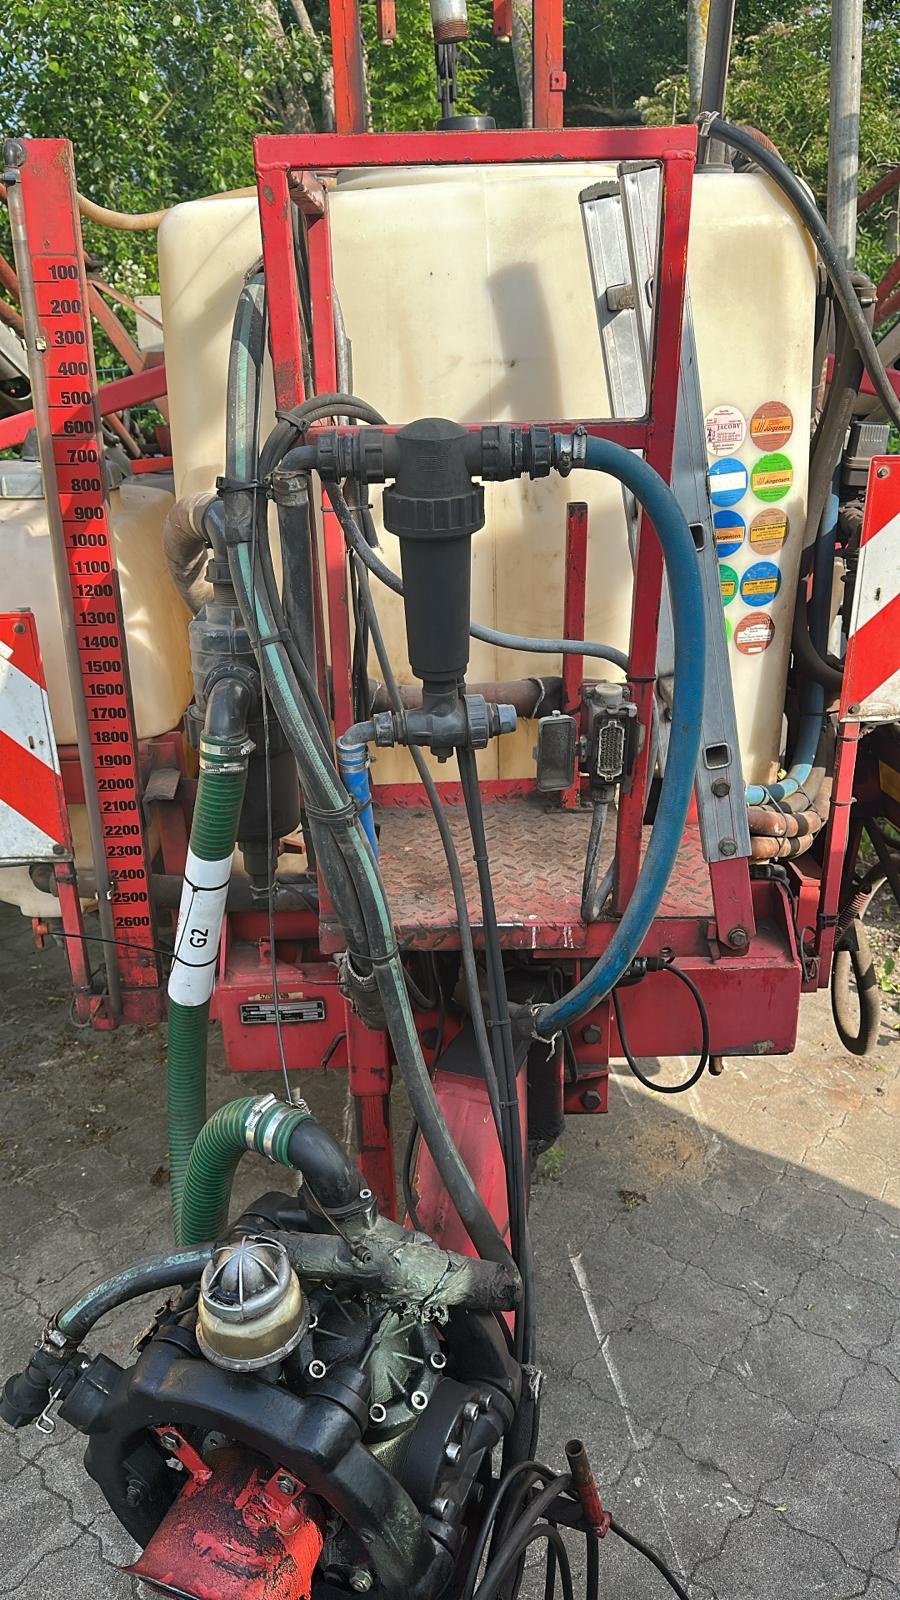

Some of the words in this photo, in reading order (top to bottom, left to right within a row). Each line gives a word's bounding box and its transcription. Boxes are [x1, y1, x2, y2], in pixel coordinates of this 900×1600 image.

[49, 266, 78, 279] 100
[51, 300, 80, 313] 200
[55, 331, 84, 344] 300
[58, 362, 88, 375] 400
[61, 392, 91, 404] 500
[64, 421, 93, 433] 600
[67, 450, 97, 462] 700
[72, 479, 100, 491] 800
[74, 507, 103, 519] 900
[70, 534, 107, 546] 1000
[75, 561, 110, 573] 1100
[76, 585, 112, 596] 1200
[80, 612, 115, 624] 1300
[83, 636, 118, 647] 1400
[86, 661, 121, 672] 1500
[89, 684, 123, 695] 1600
[92, 708, 126, 718] 1700
[94, 732, 128, 743] 1800
[97, 755, 131, 766] 1900
[98, 779, 134, 790] 2000
[103, 801, 137, 811] 2100
[105, 825, 139, 835] 2200
[108, 845, 142, 856] 2300
[111, 869, 144, 880] 2400
[114, 892, 147, 902] 2500
[116, 917, 149, 926] 2600
[190, 928, 209, 948] G2
